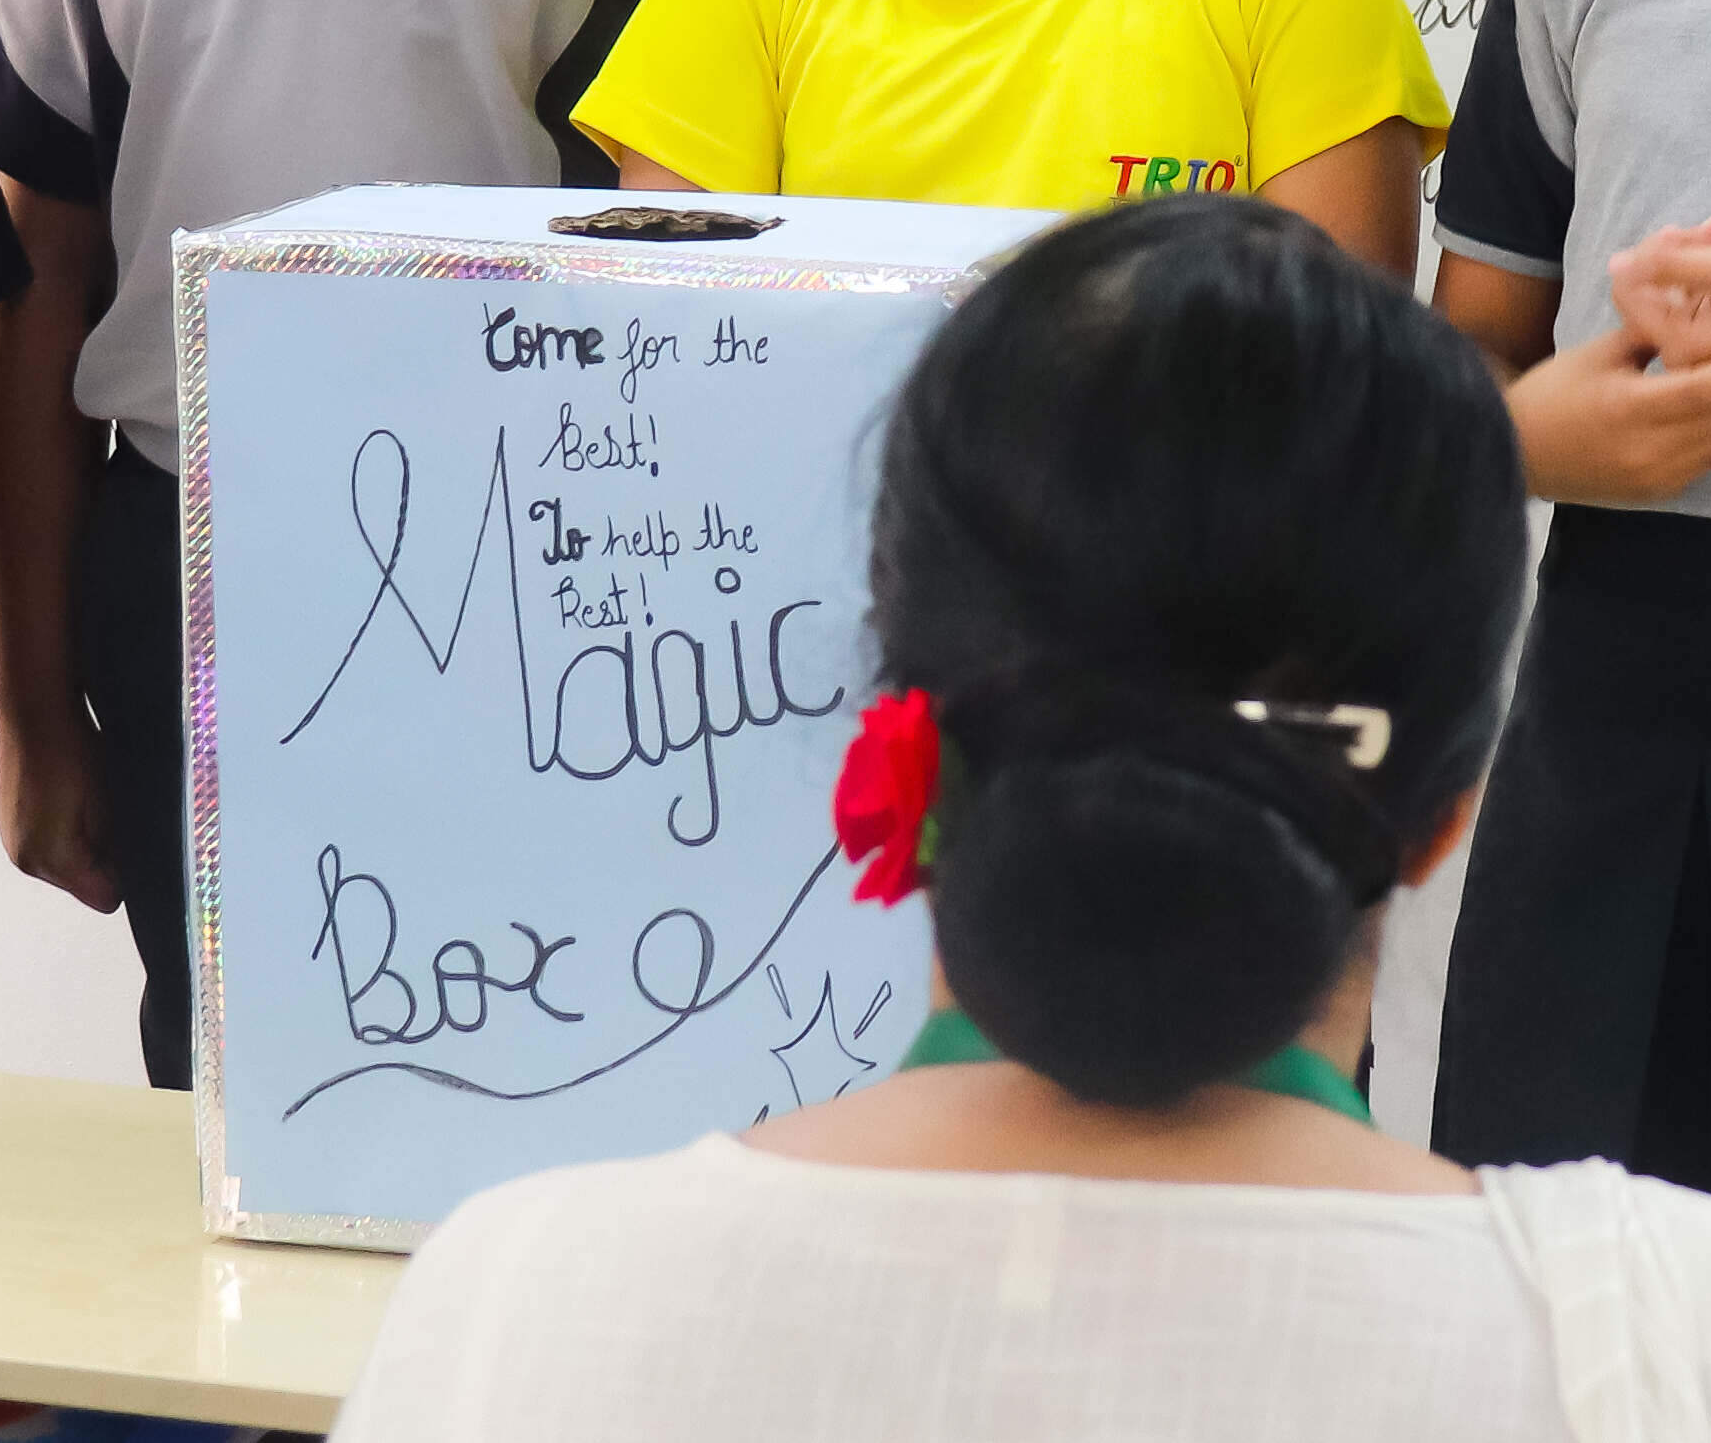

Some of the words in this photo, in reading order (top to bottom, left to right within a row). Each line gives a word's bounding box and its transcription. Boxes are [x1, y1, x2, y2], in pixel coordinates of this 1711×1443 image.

[1109, 155, 1236, 197] TRIO
[617, 317, 682, 404] for
[703, 315, 770, 367] the
[538, 401, 660, 478] Best!
[528, 496, 592, 566] To
[600, 509, 682, 572] help
[692, 501, 760, 554] the
[279, 423, 847, 848] Magic
[311, 843, 586, 1045] Box
